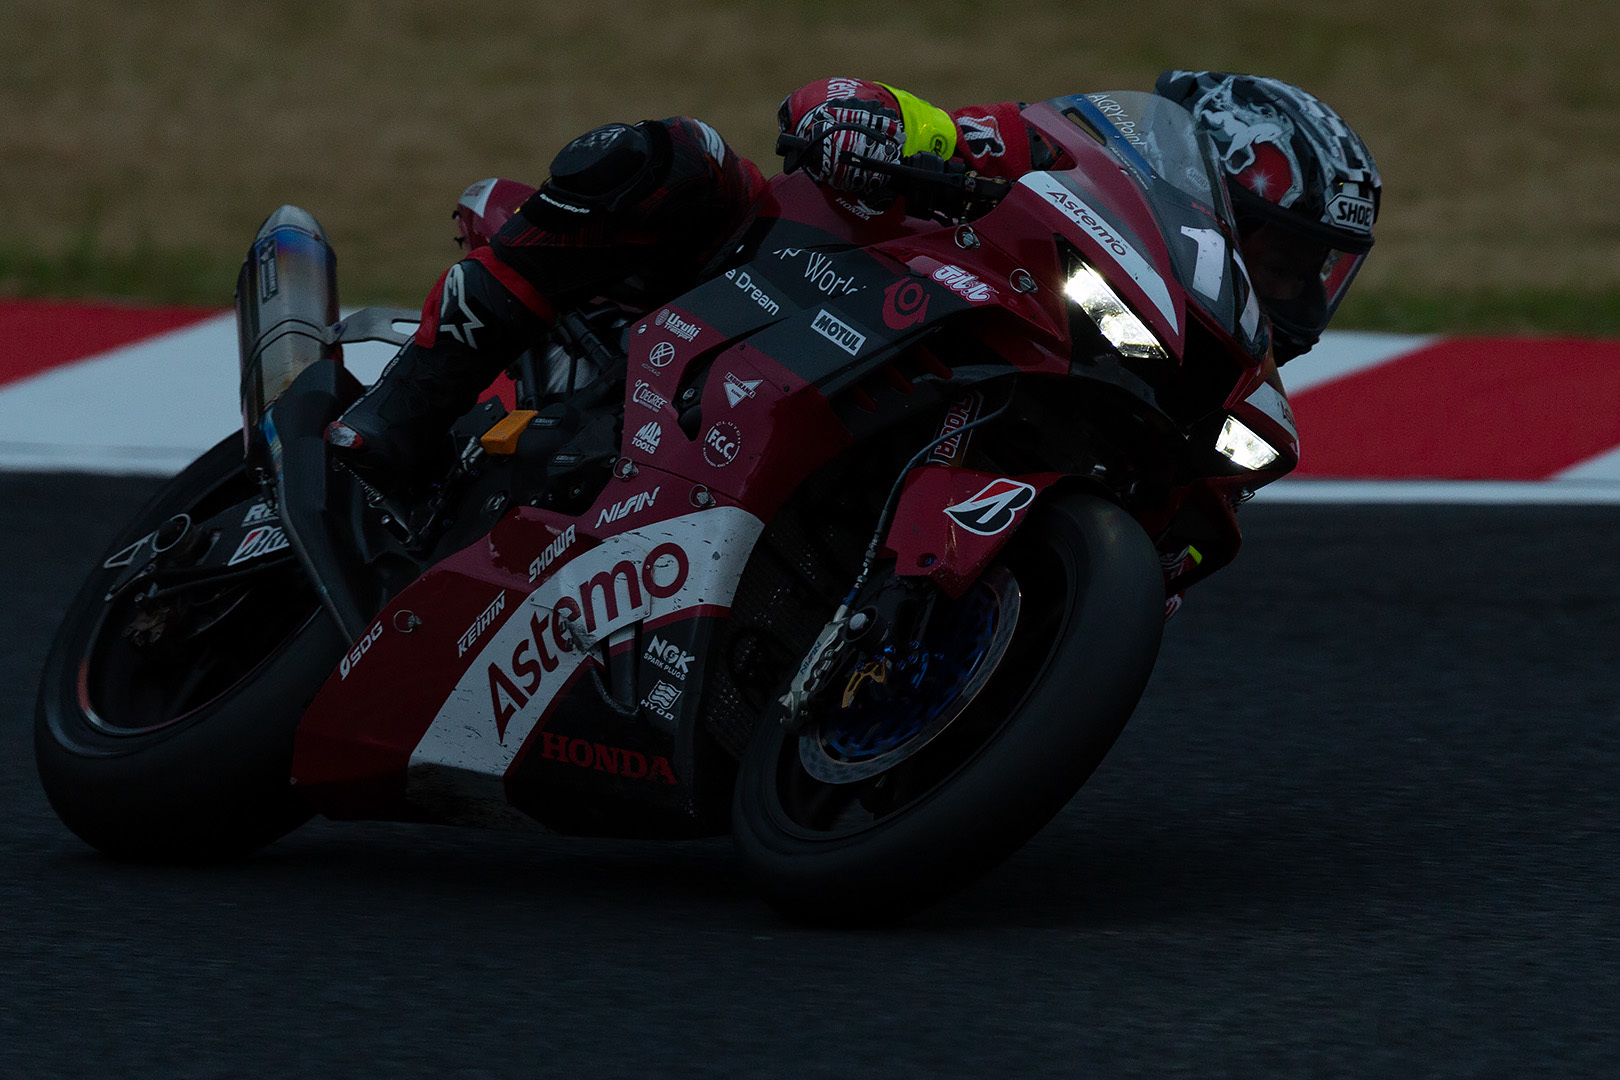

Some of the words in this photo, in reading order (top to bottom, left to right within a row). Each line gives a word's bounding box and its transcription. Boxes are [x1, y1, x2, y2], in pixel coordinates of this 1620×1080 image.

[835, 197, 870, 221] HONDA
[1046, 191, 1127, 256] Astemo
[734, 271, 781, 317] Dream
[667, 313, 702, 340] Usuki
[814, 313, 861, 353] MOTUL
[632, 437, 657, 455] TOOLS
[635, 421, 662, 447] MAC
[529, 524, 576, 583] SHOWA
[457, 589, 505, 658] KEIHIN
[487, 542, 689, 747] Astemo
[647, 634, 696, 674] NGK
[643, 653, 664, 669] SPARK
[662, 663, 687, 681] PLUGS
[640, 699, 675, 721] HYOD
[541, 731, 680, 785] HONDA
